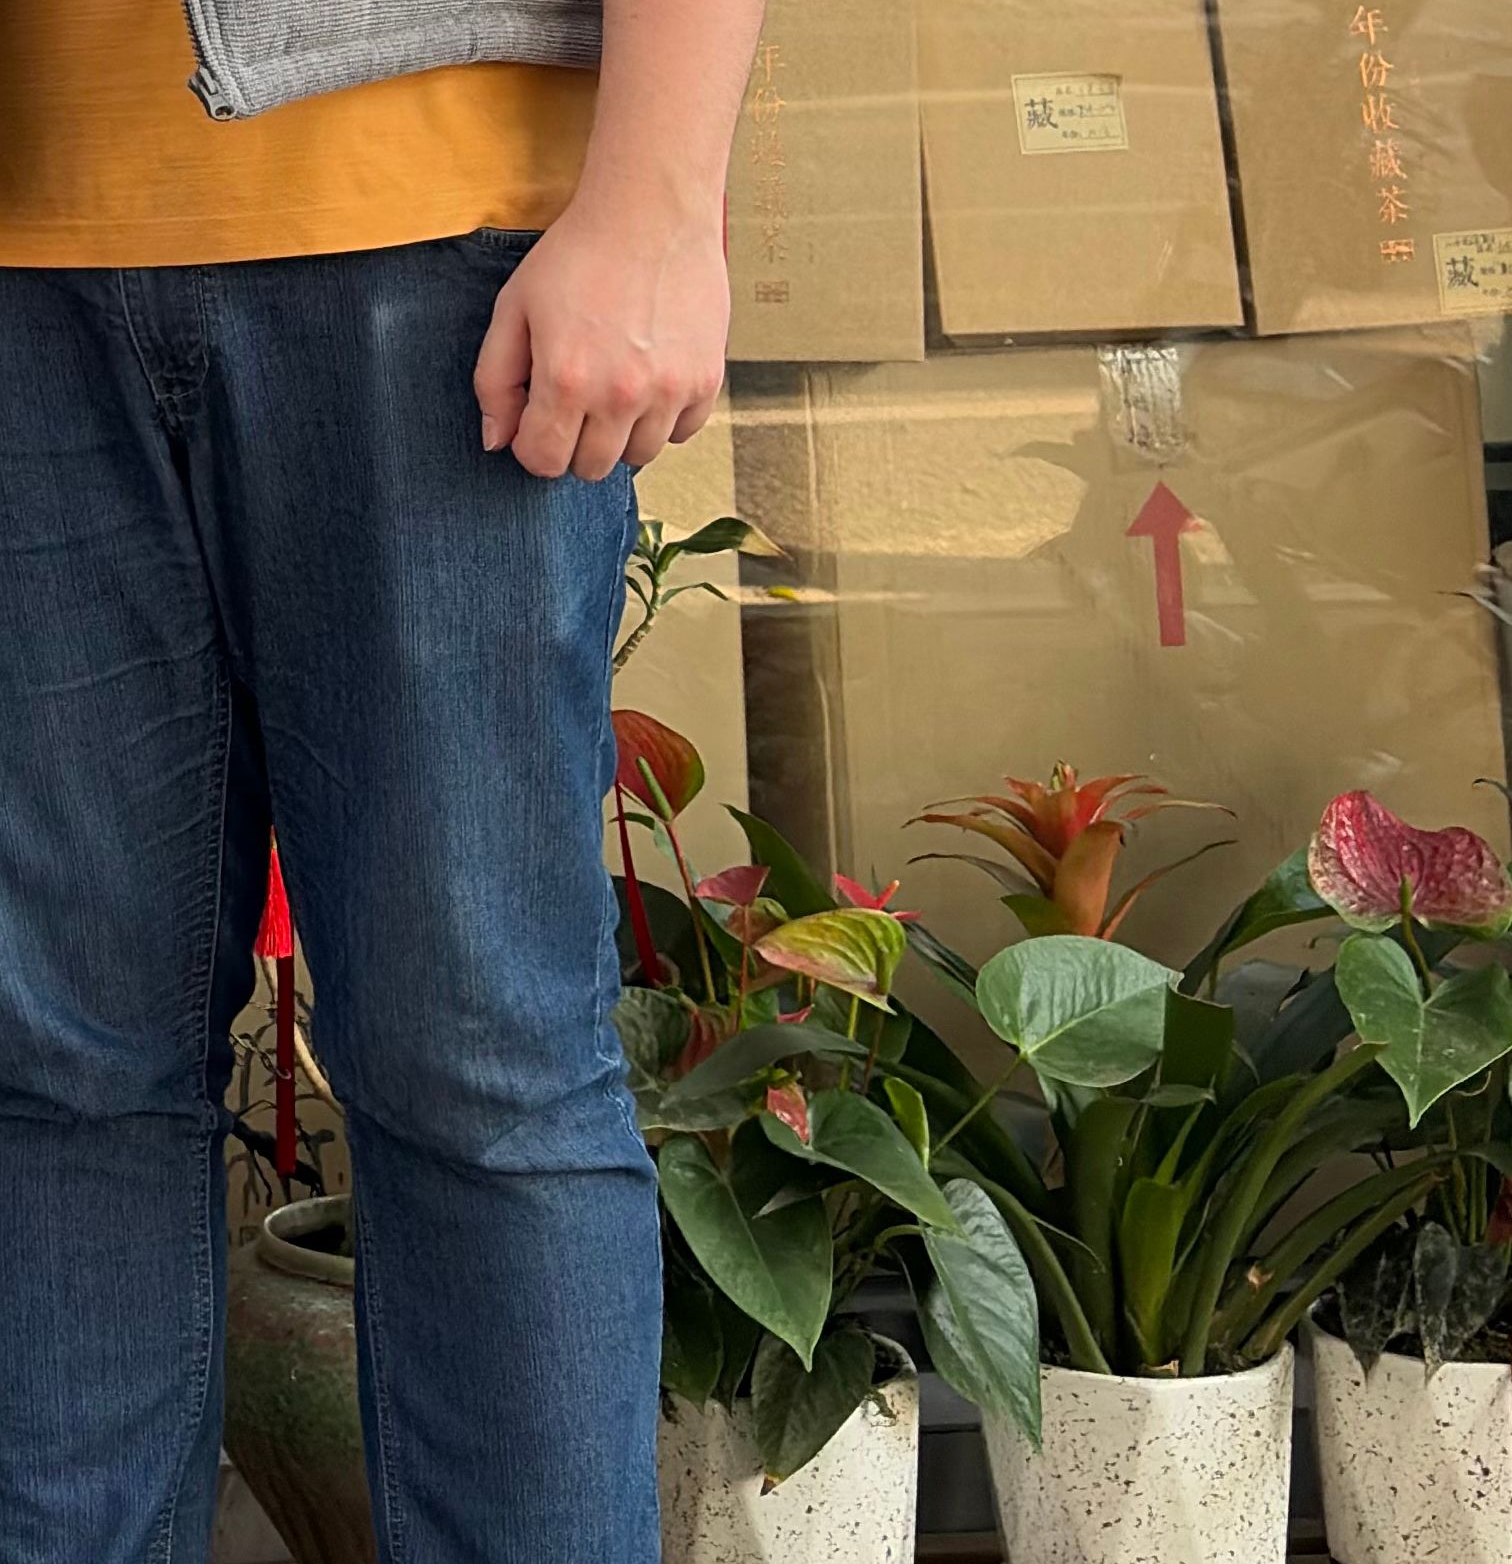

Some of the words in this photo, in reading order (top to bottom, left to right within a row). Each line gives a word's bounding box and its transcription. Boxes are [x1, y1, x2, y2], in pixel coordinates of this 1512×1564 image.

[1349, 5, 1411, 224] 年份收藏茶
